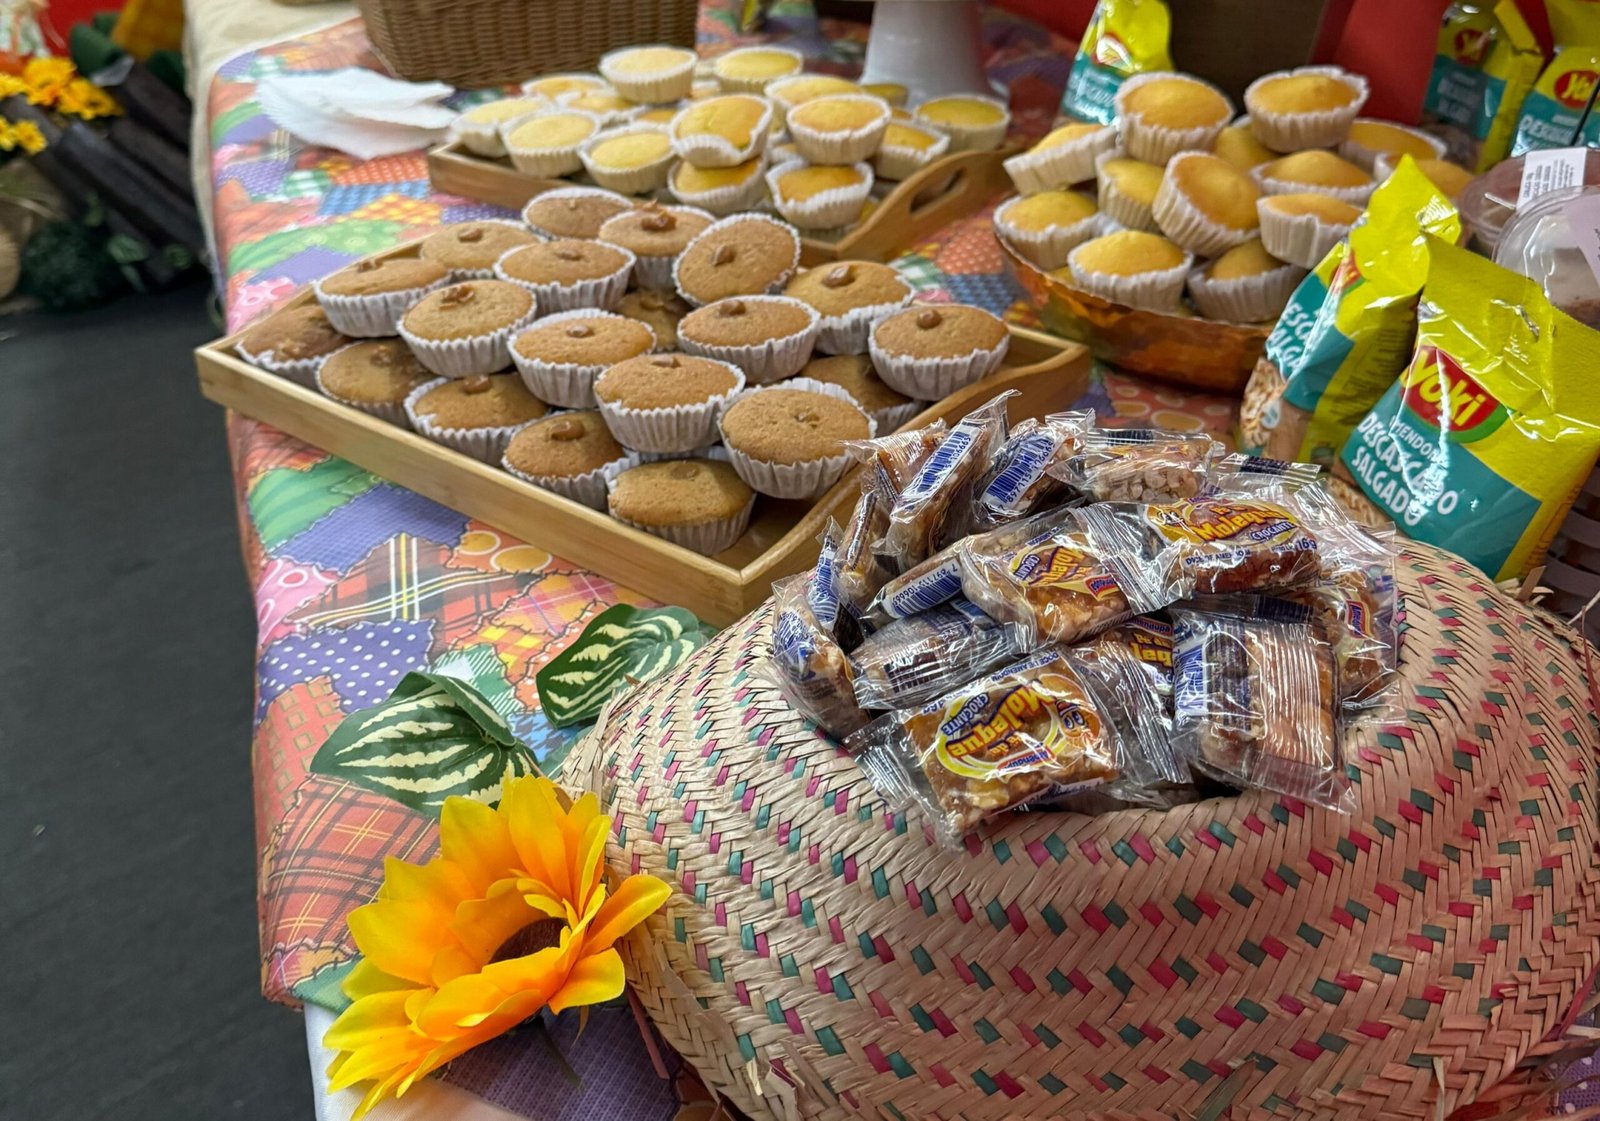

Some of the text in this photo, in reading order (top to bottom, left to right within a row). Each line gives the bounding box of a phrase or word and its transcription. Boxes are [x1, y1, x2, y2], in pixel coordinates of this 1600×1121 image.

[1400, 350, 1486, 427] Yoki
[1352, 446, 1425, 526] SALGADO
[1357, 412, 1458, 515] DESCASCADO
[1296, 537, 1318, 551] 16g
[942, 694, 988, 735] CROCANTE
[949, 687, 1055, 757] Moleque
